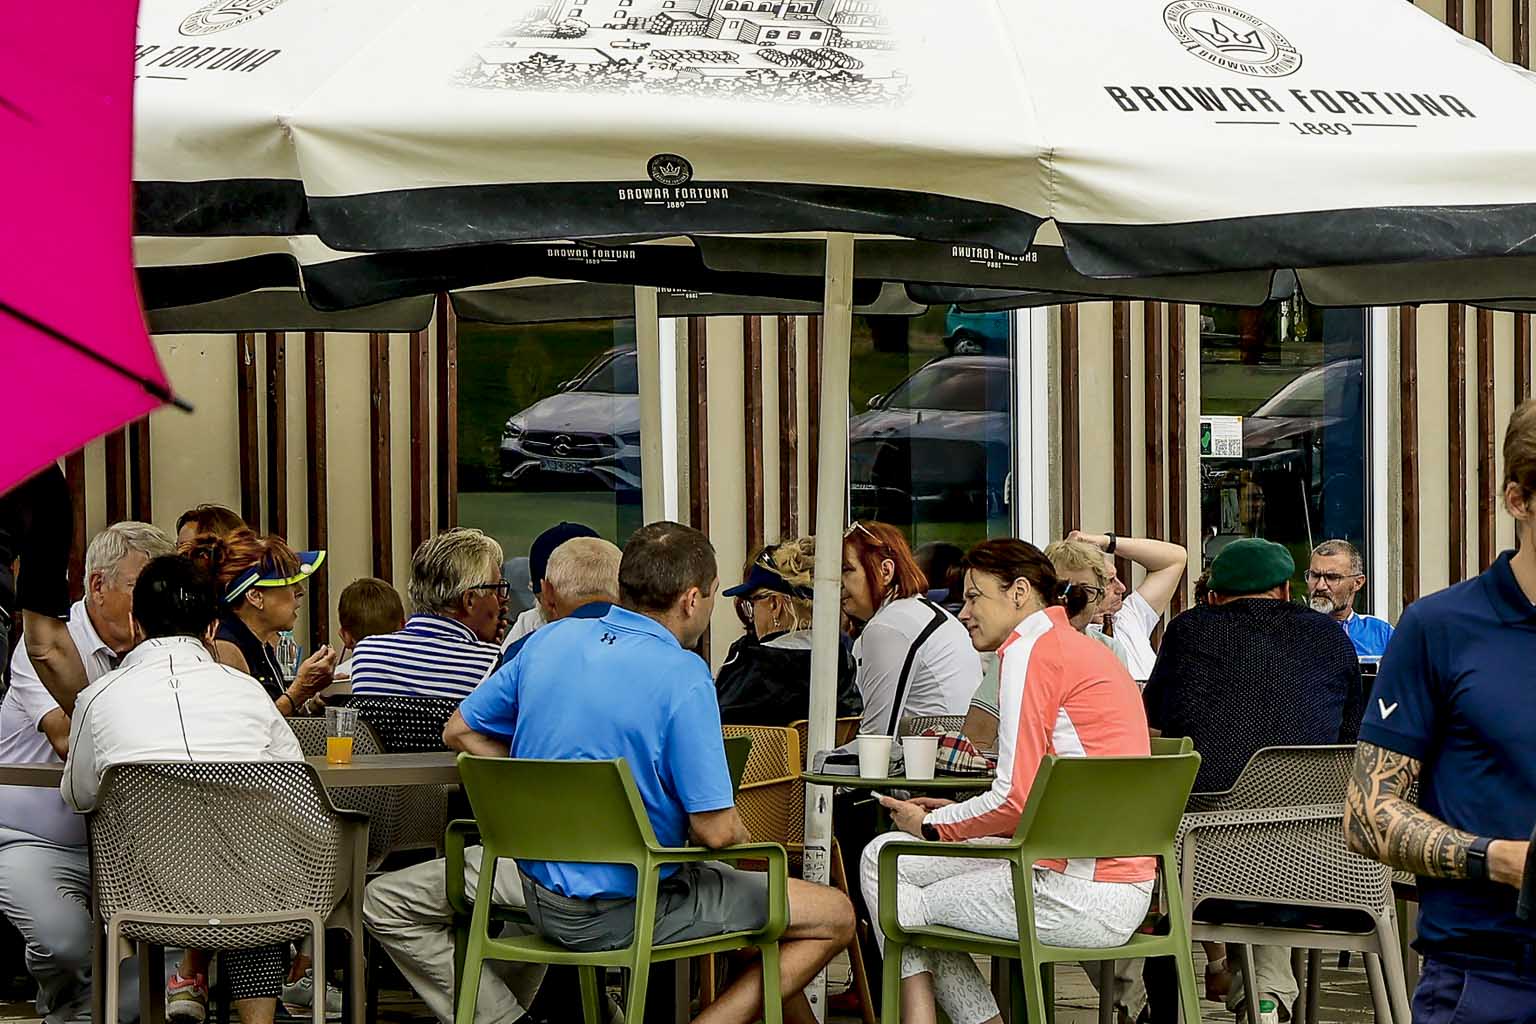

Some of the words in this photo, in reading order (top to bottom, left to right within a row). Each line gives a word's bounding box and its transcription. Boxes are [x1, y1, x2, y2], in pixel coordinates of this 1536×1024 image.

[145, 45, 281, 73] FORTUNA
[1104, 86, 1285, 112] BROWAR
[1288, 88, 1478, 118] FORTUNA
[1289, 122, 1353, 136] 1889
[619, 188, 670, 200] BROWAR
[675, 187, 729, 199] FORTUNA
[666, 201, 685, 209] 1889
[547, 248, 589, 258] BROWAR
[592, 249, 636, 259] FORTUNA
